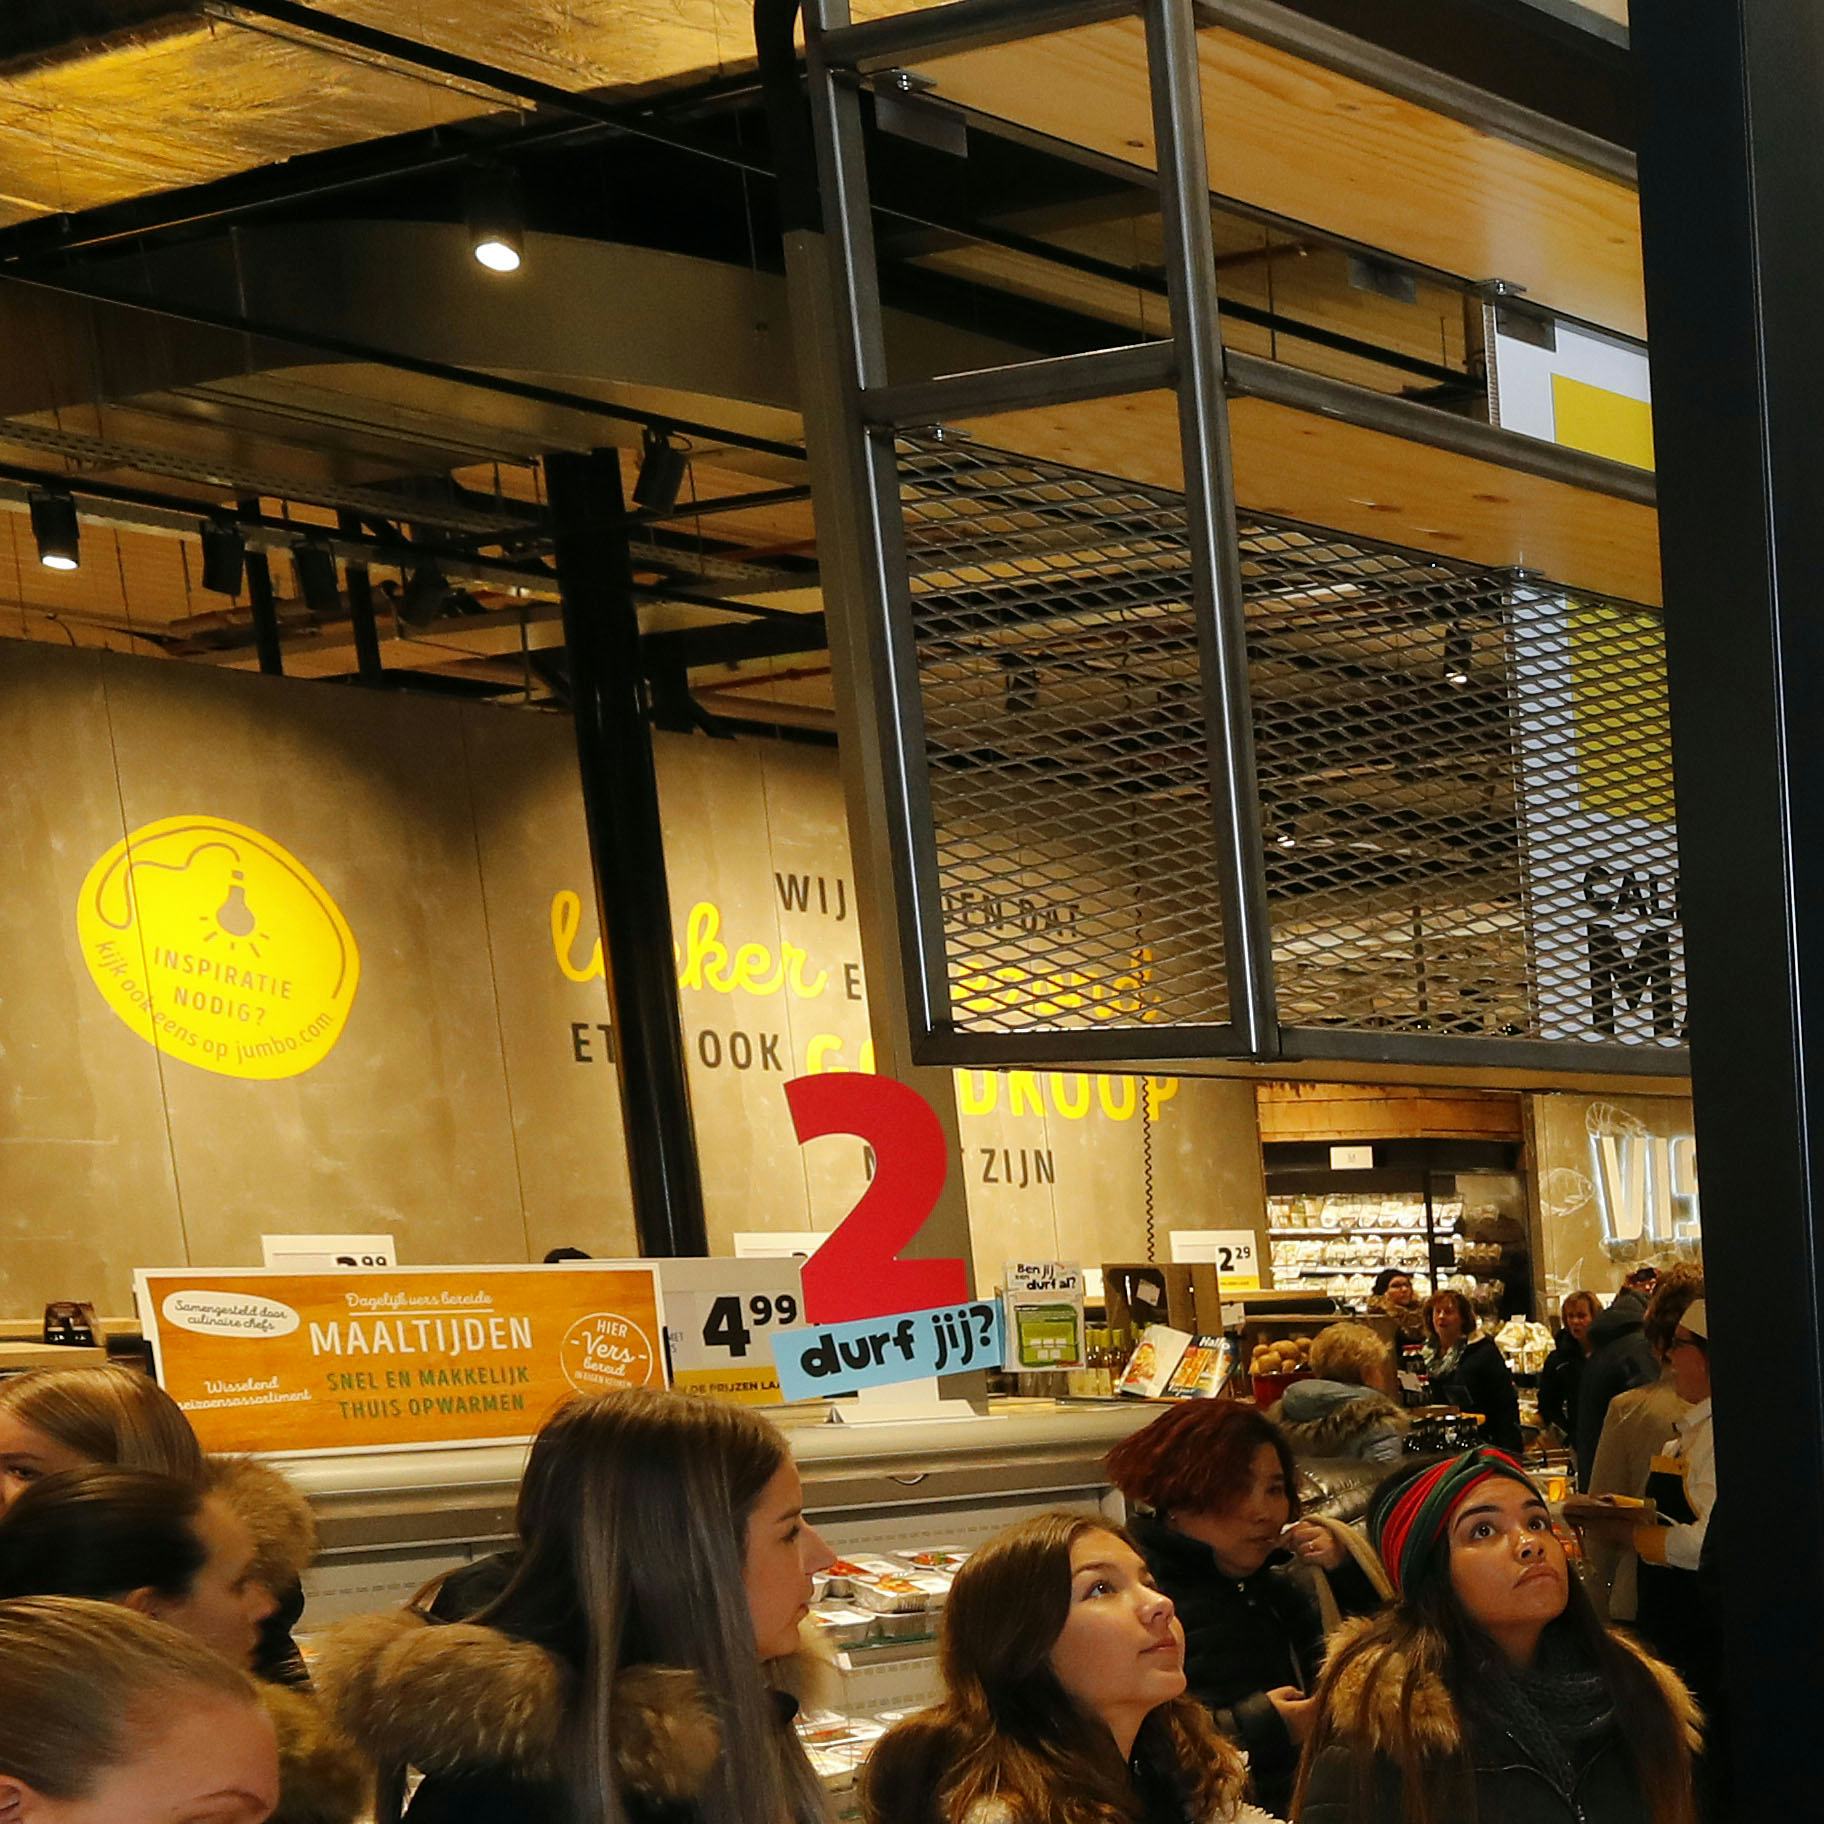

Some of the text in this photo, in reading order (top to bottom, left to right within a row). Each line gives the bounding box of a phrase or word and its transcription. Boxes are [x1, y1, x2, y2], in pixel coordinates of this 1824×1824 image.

[775, 872, 847, 922] WIJ
[551, 889, 827, 998] lker
[154, 946, 293, 1000] INSPIRATIE
[95, 940, 126, 978] kijk
[151, 1011, 199, 1048] eens
[203, 1035, 229, 1061] op
[235, 1010, 334, 1064] jumbo.com
[173, 986, 267, 1026] NODIG?
[699, 1029, 783, 1072] OOK
[980, 1148, 1056, 1188] ZIJN
[784, 1072, 970, 1325] 2
[1017, 1263, 1041, 1275] Ben
[1027, 1278, 1057, 1291] durf
[308, 1317, 533, 1356] MAALTIJDEN
[581, 1330, 636, 1364] Vers
[596, 1319, 628, 1338] HIER
[800, 1305, 994, 1377] durf jij?
[204, 1376, 280, 1394] Wisselend
[326, 1366, 529, 1391] SNEL EN MAKKELIJK
[340, 1394, 525, 1419] THUIS OPWARMEN
